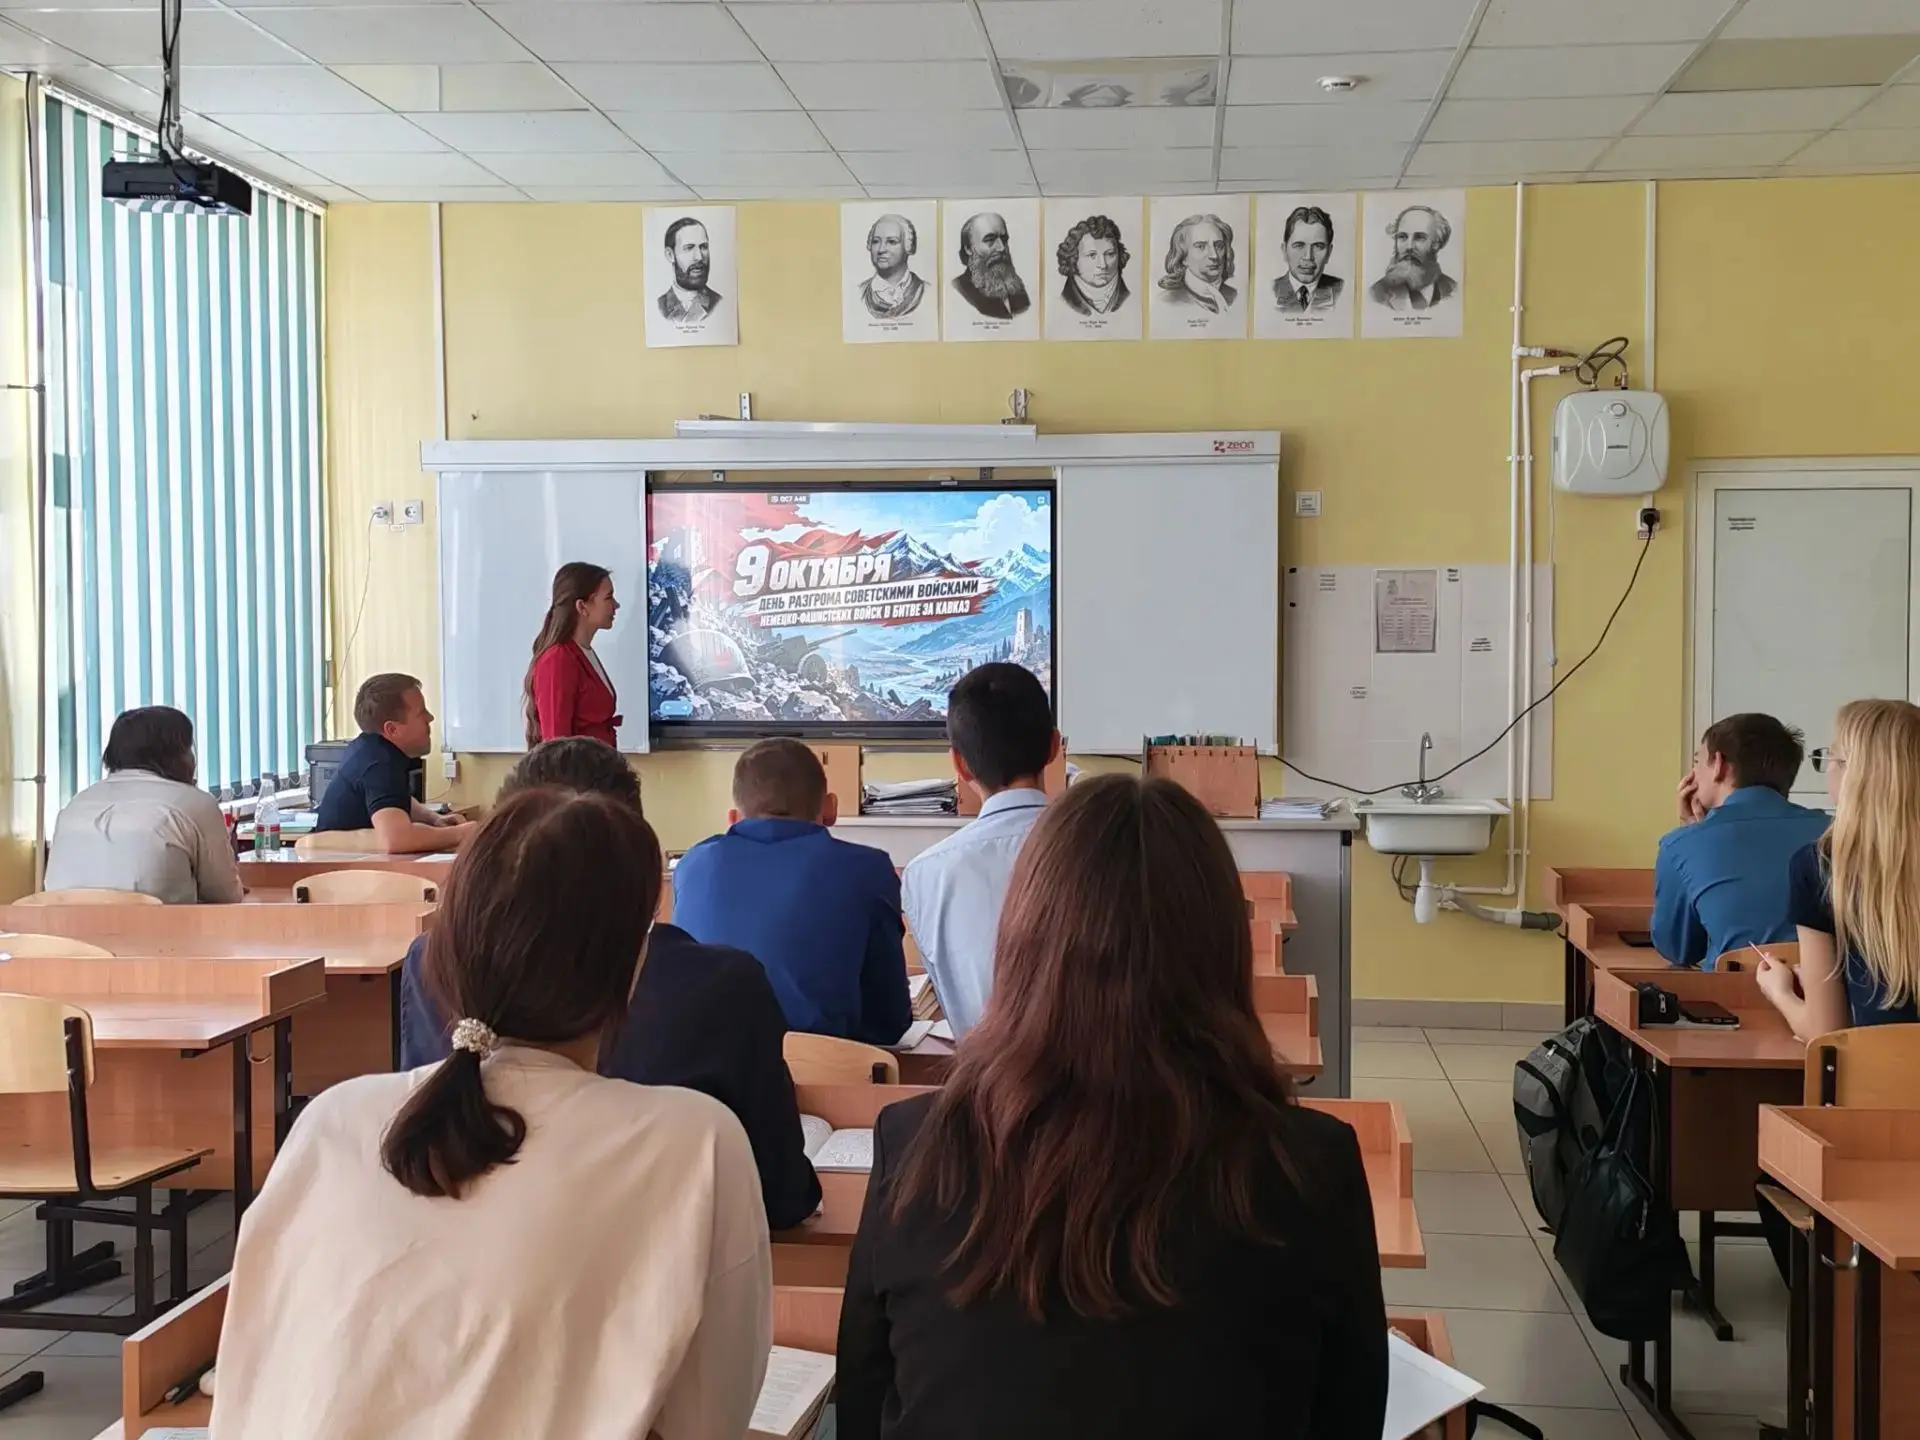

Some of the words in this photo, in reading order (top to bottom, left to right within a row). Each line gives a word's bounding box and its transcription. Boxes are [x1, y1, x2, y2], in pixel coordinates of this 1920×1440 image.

[1227, 441, 1254, 449] zeon
[733, 545, 770, 596] 9
[769, 553, 892, 590] ОКТЯБРЯ
[759, 598, 785, 611] ДЕНЬ
[788, 591, 842, 609] РАЗГРОМА
[844, 585, 914, 604] СОВЕТСКИМИ
[917, 580, 979, 598] ВОЙСКАМИ
[759, 609, 851, 627] НЕМЕЦКО-ФАШИСТСКИХ
[854, 605, 882, 621] ВОЙСК
[884, 606, 890, 618] В
[892, 603, 920, 618] БИТВЕ
[922, 602, 934, 616] ЗА
[935, 600, 970, 614] КАВКАЗ
